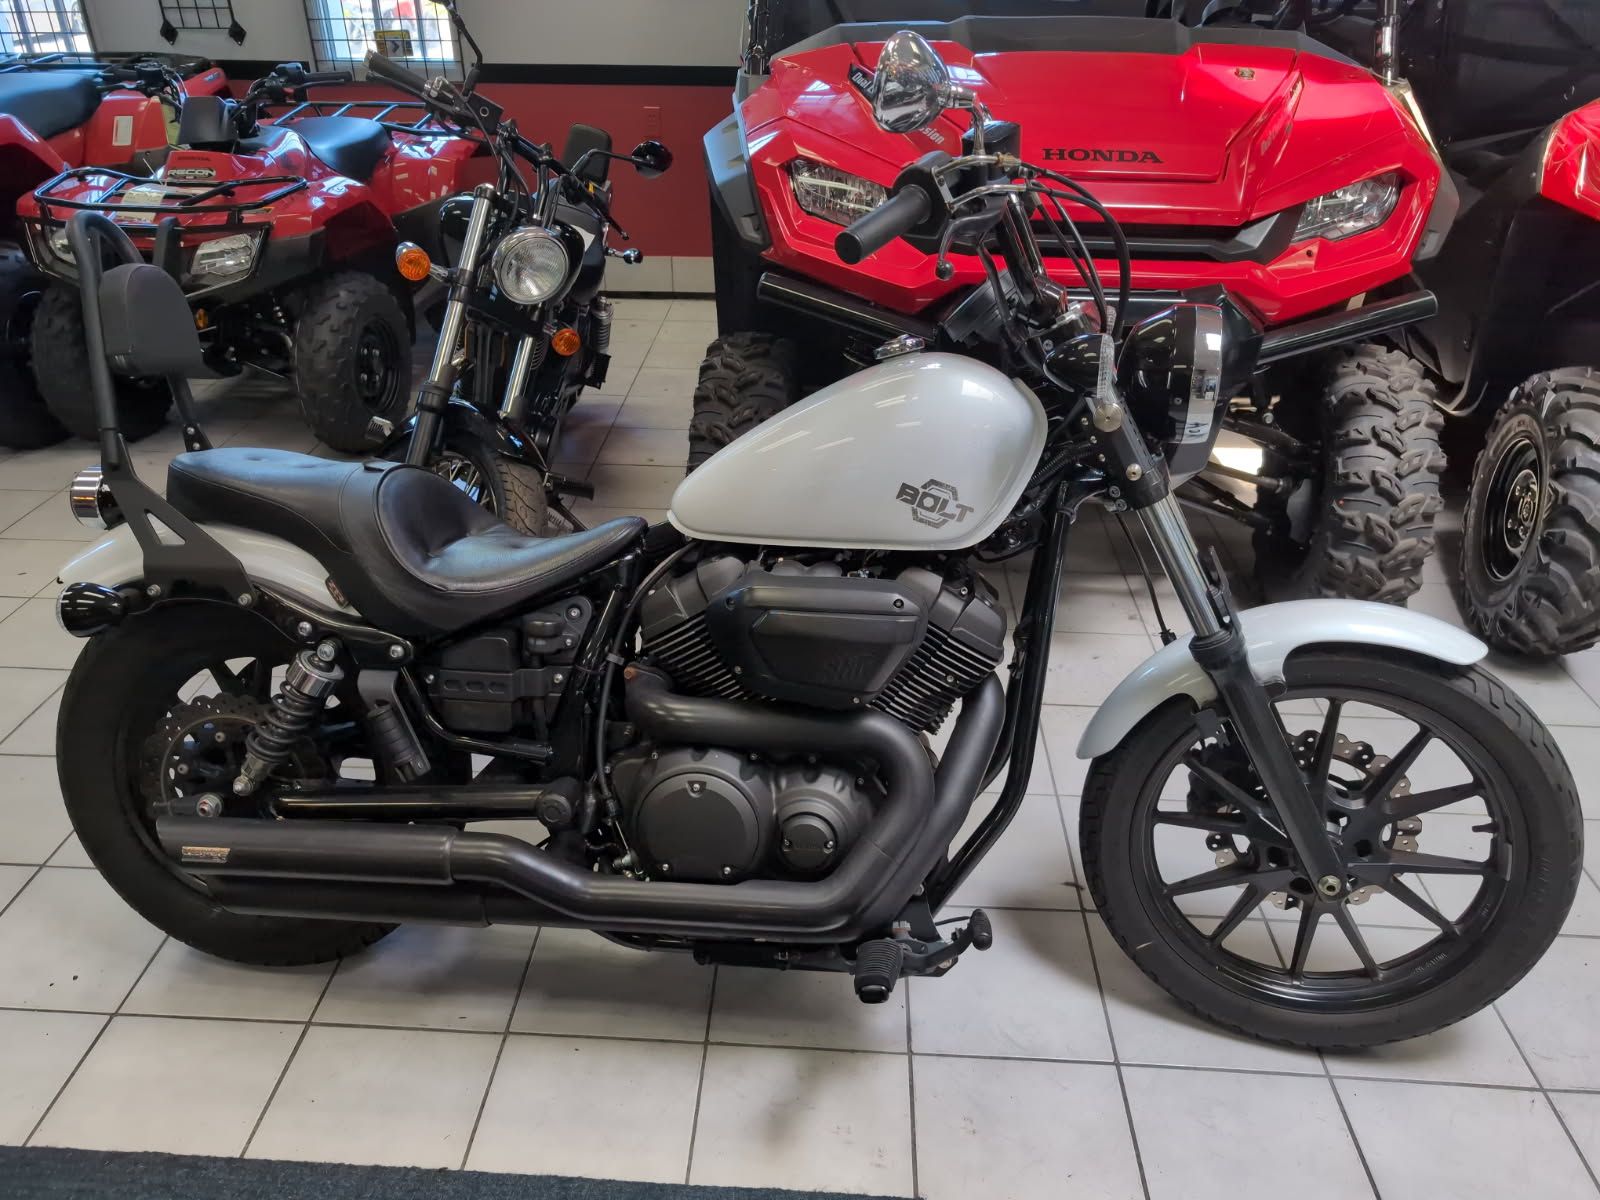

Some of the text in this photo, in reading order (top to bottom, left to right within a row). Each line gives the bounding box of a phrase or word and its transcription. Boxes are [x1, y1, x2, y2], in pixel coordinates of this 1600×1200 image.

[851, 72, 872, 91] Dual
[919, 126, 945, 145] sion
[1042, 148, 1165, 164] HONDA
[167, 168, 216, 177] RECON
[896, 482, 975, 522] BOLT
